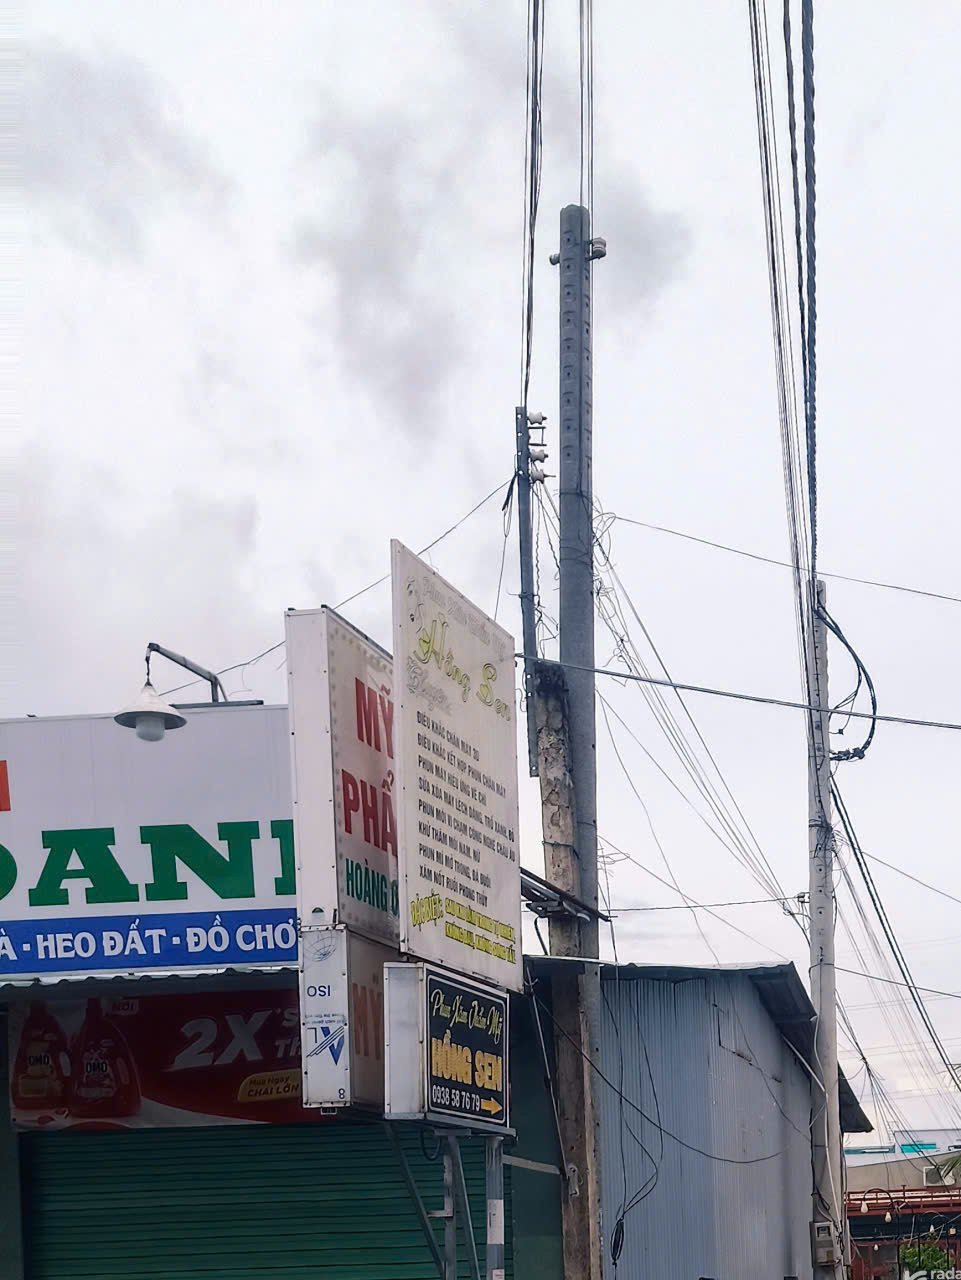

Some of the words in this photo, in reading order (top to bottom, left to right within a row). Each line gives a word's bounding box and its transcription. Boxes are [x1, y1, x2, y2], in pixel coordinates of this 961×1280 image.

[418, 754, 434, 775] PHUN
[418, 798, 435, 819] PHUN
[419, 843, 435, 863] PHUN
[345, 857, 389, 914] HOÀNG
[36, 931, 97, 959] HEO
[102, 918, 167, 956] ĐẤT
[185, 914, 230, 948] ĐỒ
[173, 1010, 272, 1068] 2X
[431, 1028, 473, 1086] HỒNG
[474, 1049, 503, 1093] SEN
[432, 1084, 451, 1106] 0938
[450, 1088, 461, 1109] 58
[460, 1090, 471, 1112] 76
[470, 1092, 481, 1113] 79
